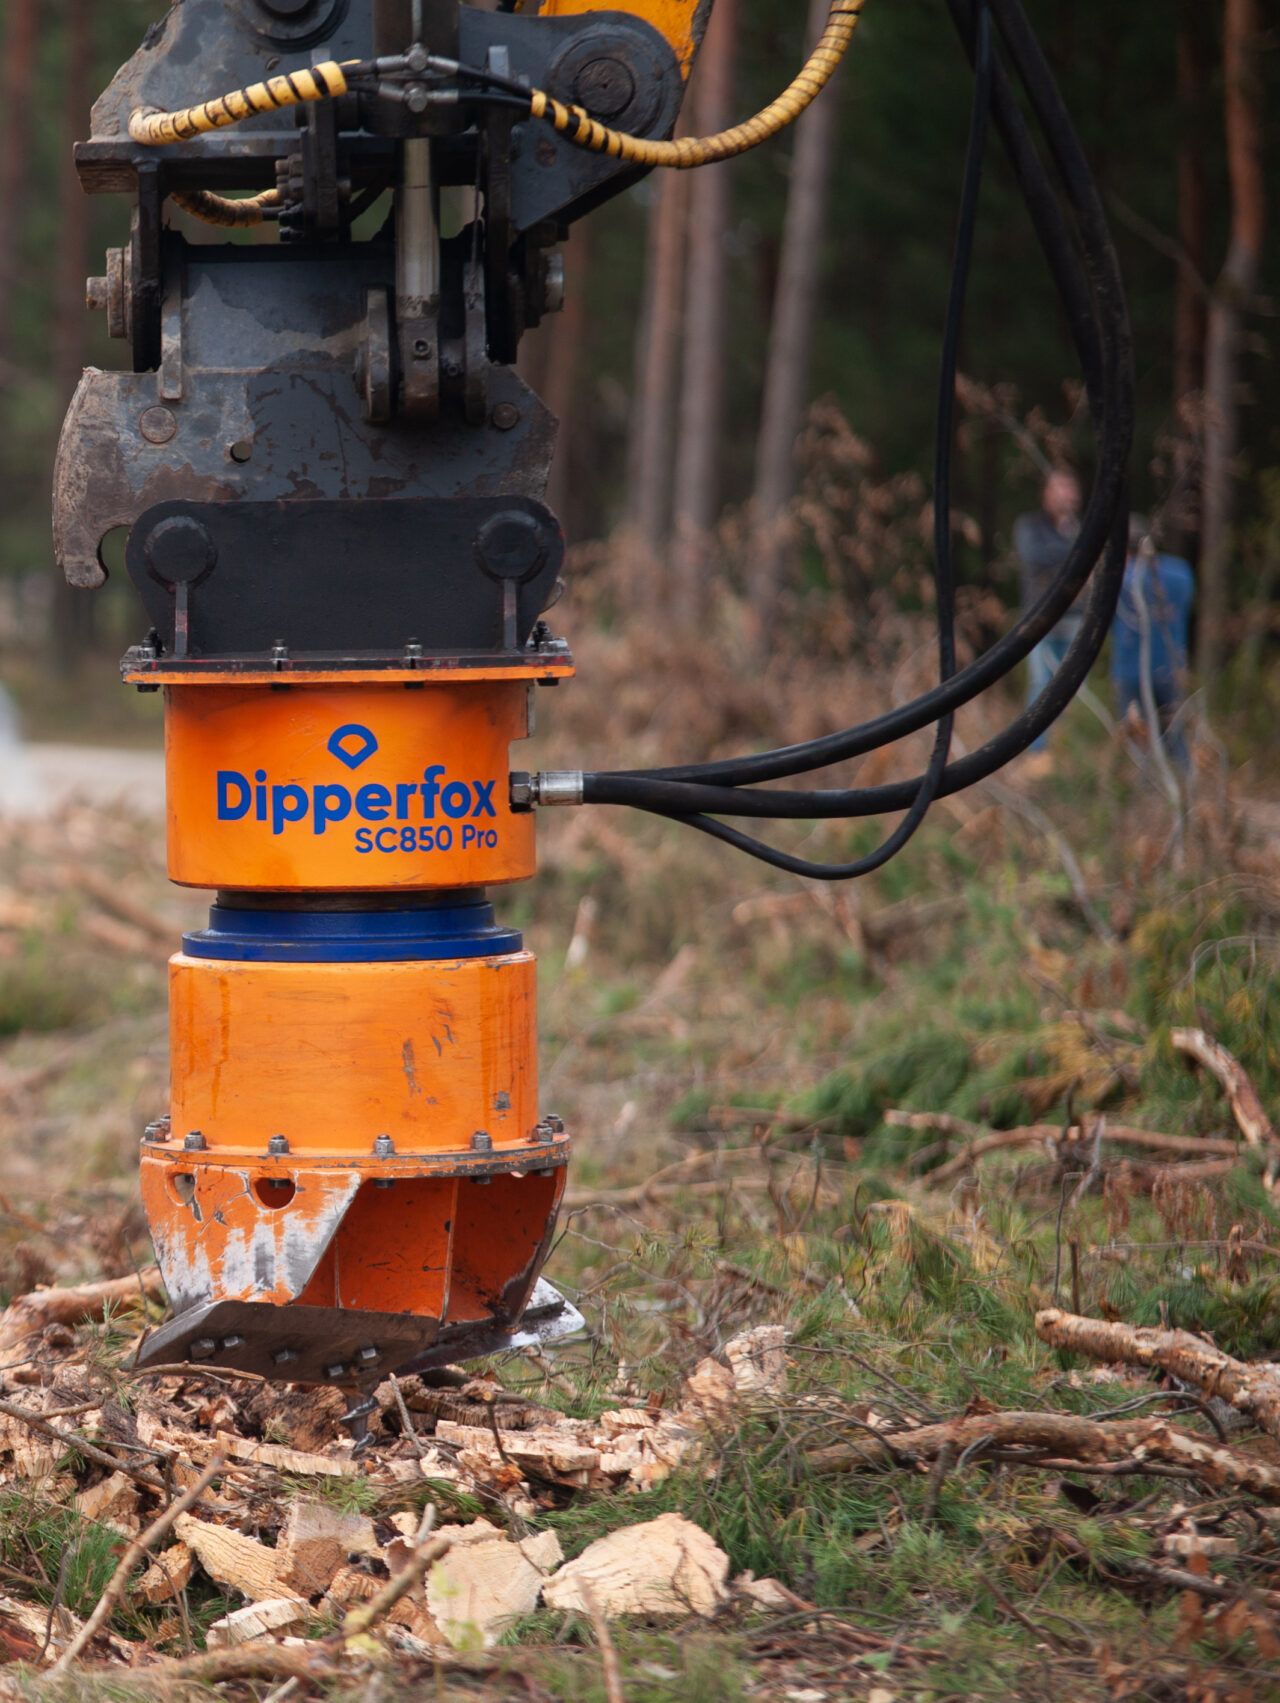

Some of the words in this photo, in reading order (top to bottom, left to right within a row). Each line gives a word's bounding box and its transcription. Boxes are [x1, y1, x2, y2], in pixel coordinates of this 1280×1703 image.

[218, 759, 496, 835] Dipperfox
[356, 826, 453, 854] SC850
[462, 825, 497, 849] Pro
